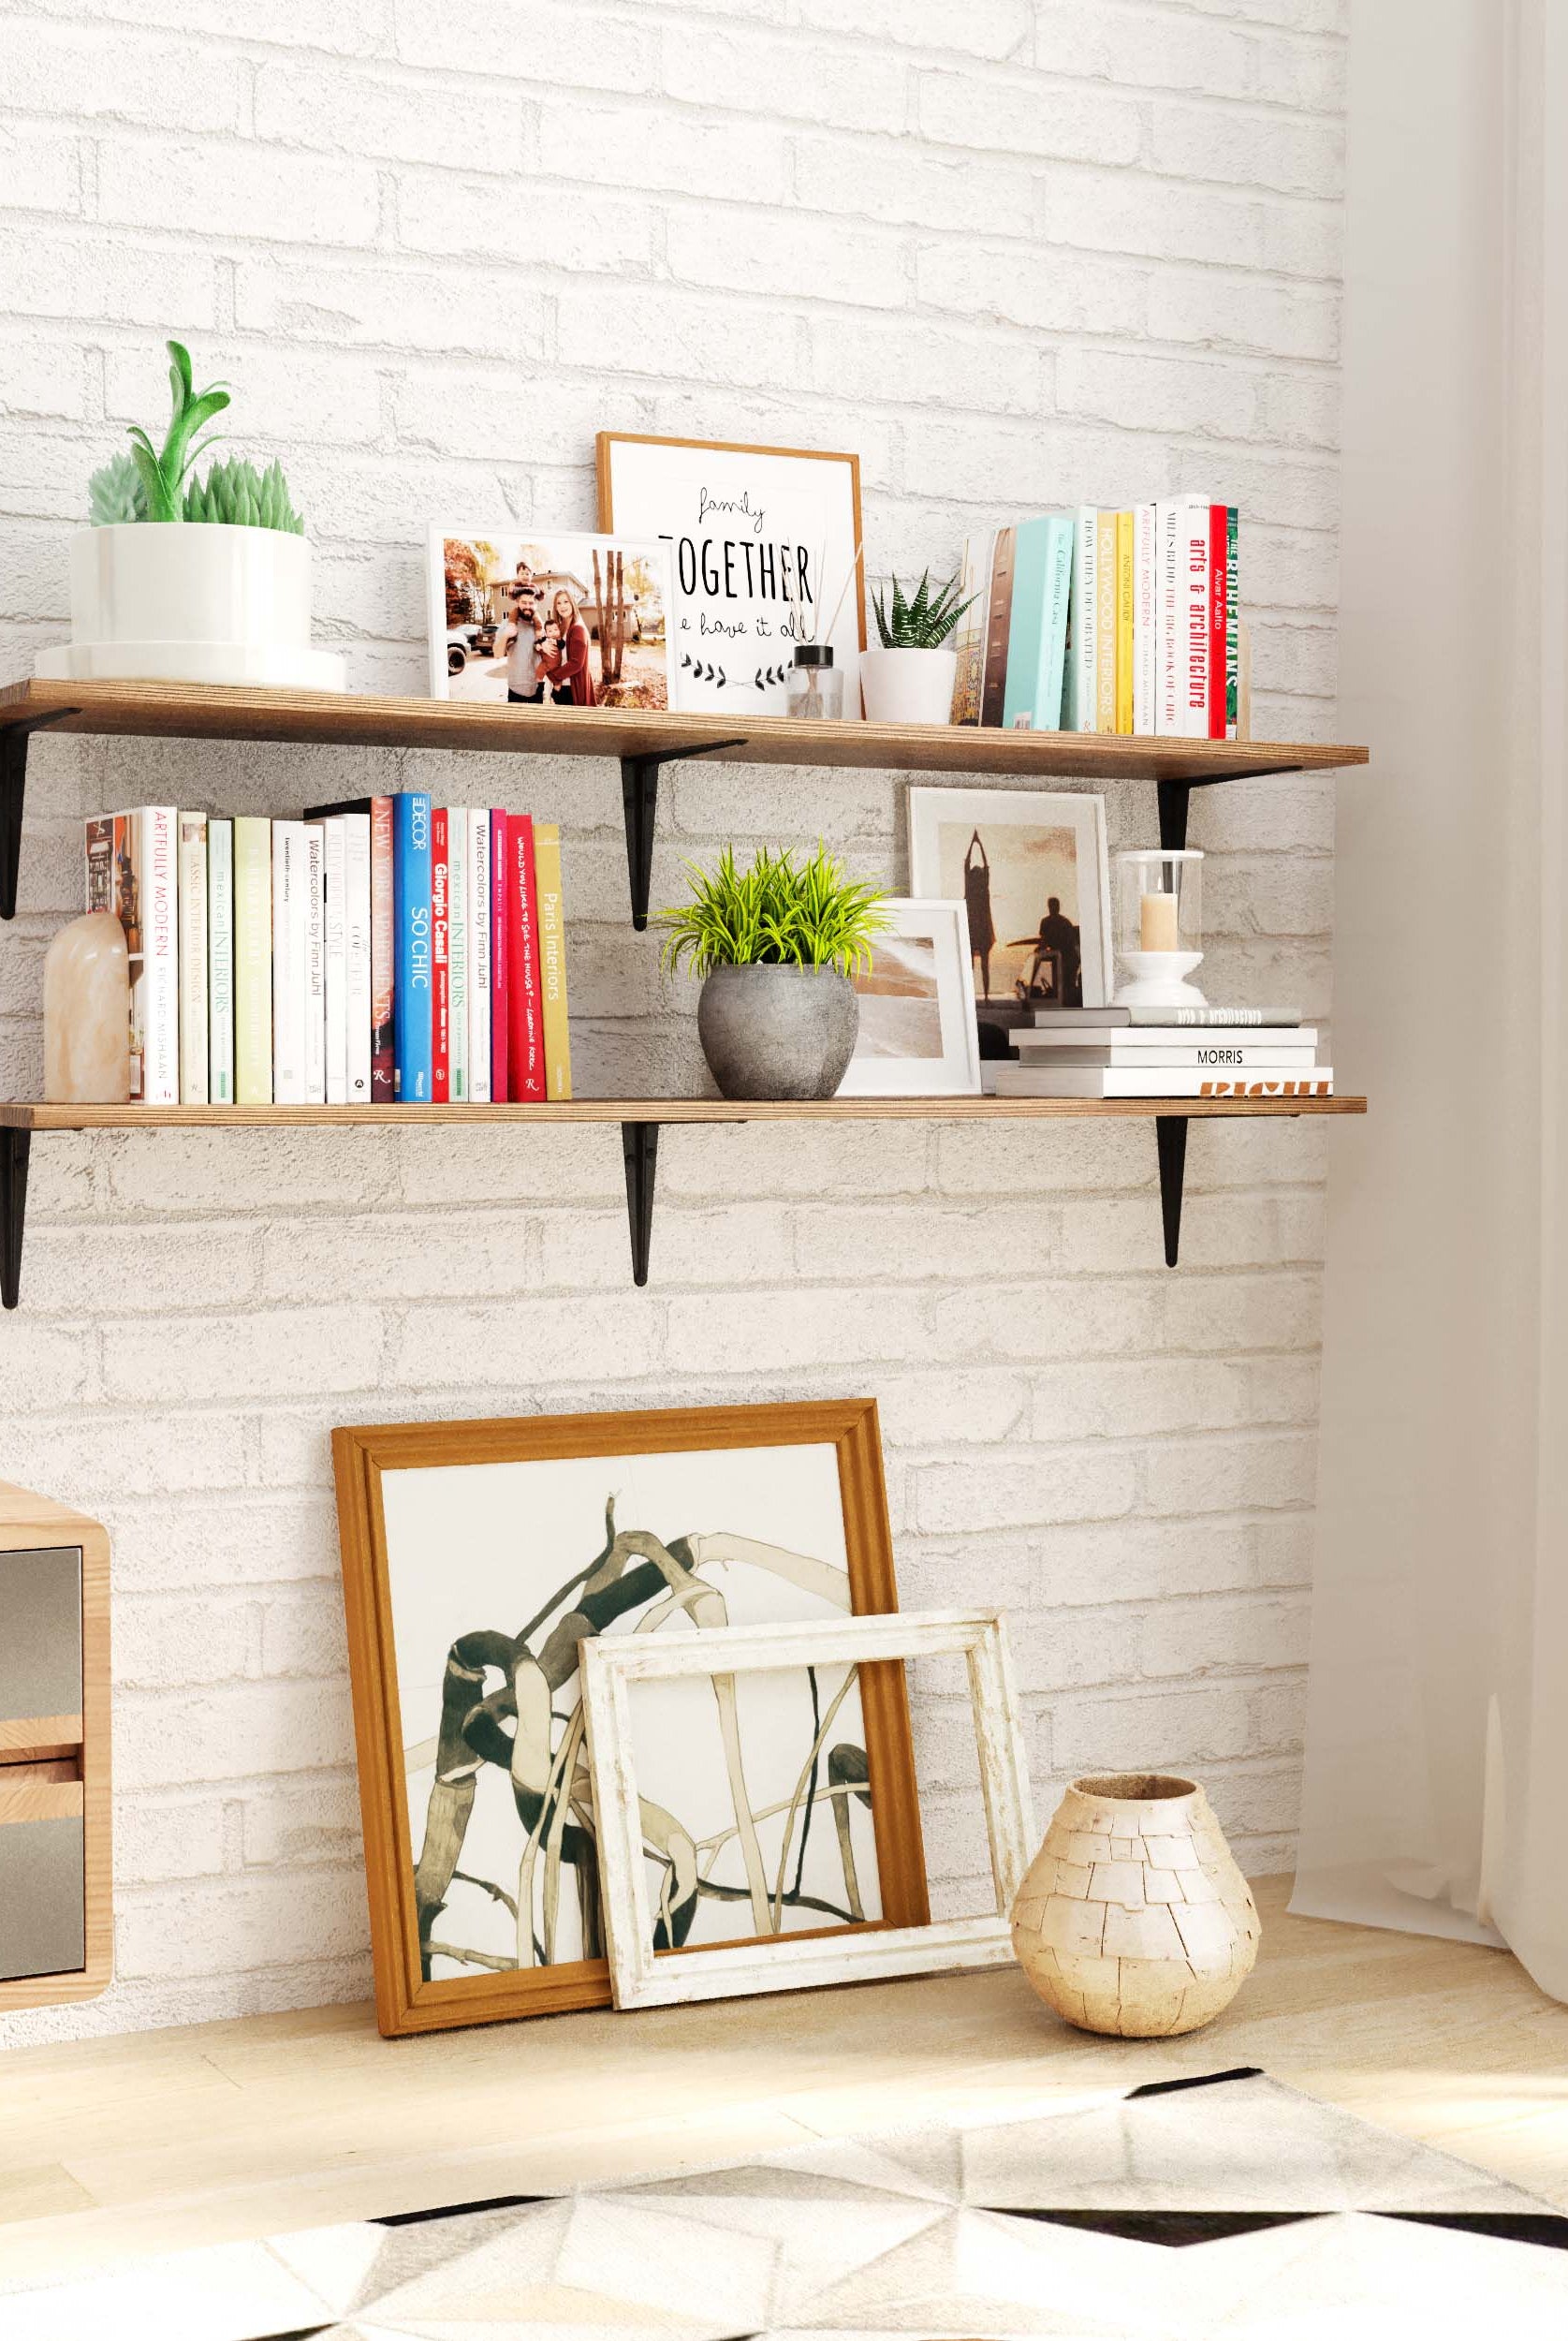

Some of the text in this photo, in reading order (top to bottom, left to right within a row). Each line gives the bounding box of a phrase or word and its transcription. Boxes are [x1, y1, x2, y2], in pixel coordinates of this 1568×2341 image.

[698, 486, 766, 534] family
[1141, 508, 1150, 566] ARTFULLY
[658, 535, 813, 604] OGETHER
[1141, 569, 1150, 627] MODERN
[700, 613, 745, 638] have
[755, 617, 772, 638] it
[780, 611, 815, 643] all
[1100, 527, 1114, 715] HOLLYWOOD INTERIORS
[1189, 539, 1208, 710] arts & architecture
[1214, 568, 1224, 630] Alvar Aalto
[154, 811, 168, 880] ARTFULLY
[374, 809, 390, 848] NEW
[517, 836, 526, 868] WOULD
[216, 871, 227, 928] mexican
[375, 856, 391, 899] YORK
[432, 862, 448, 917] Giorgio
[519, 886, 528, 911] LIKE
[154, 886, 169, 957] MODERN
[190, 898, 202, 953] INTERIOR
[309, 839, 323, 996] Watercolors by Finn Juhl
[451, 861, 465, 1009] mexican INTERIORS
[475, 824, 489, 990] Watercolors by Finn Juhl
[521, 911, 530, 923] TO
[521, 924, 531, 942] SEE
[329, 921, 344, 960] STYLE
[374, 909, 391, 1020] APARTMENTS
[411, 906, 429, 989] SO CHIC
[434, 920, 448, 964] Casali
[523, 942, 532, 963] THE
[543, 892, 563, 1001] Paris Interiors
[190, 957, 201, 1004] DESIGN
[214, 930, 229, 1014] INTERIORS
[158, 1023, 168, 1080] MISHAAN
[1197, 1050, 1244, 1066] MORRIS
